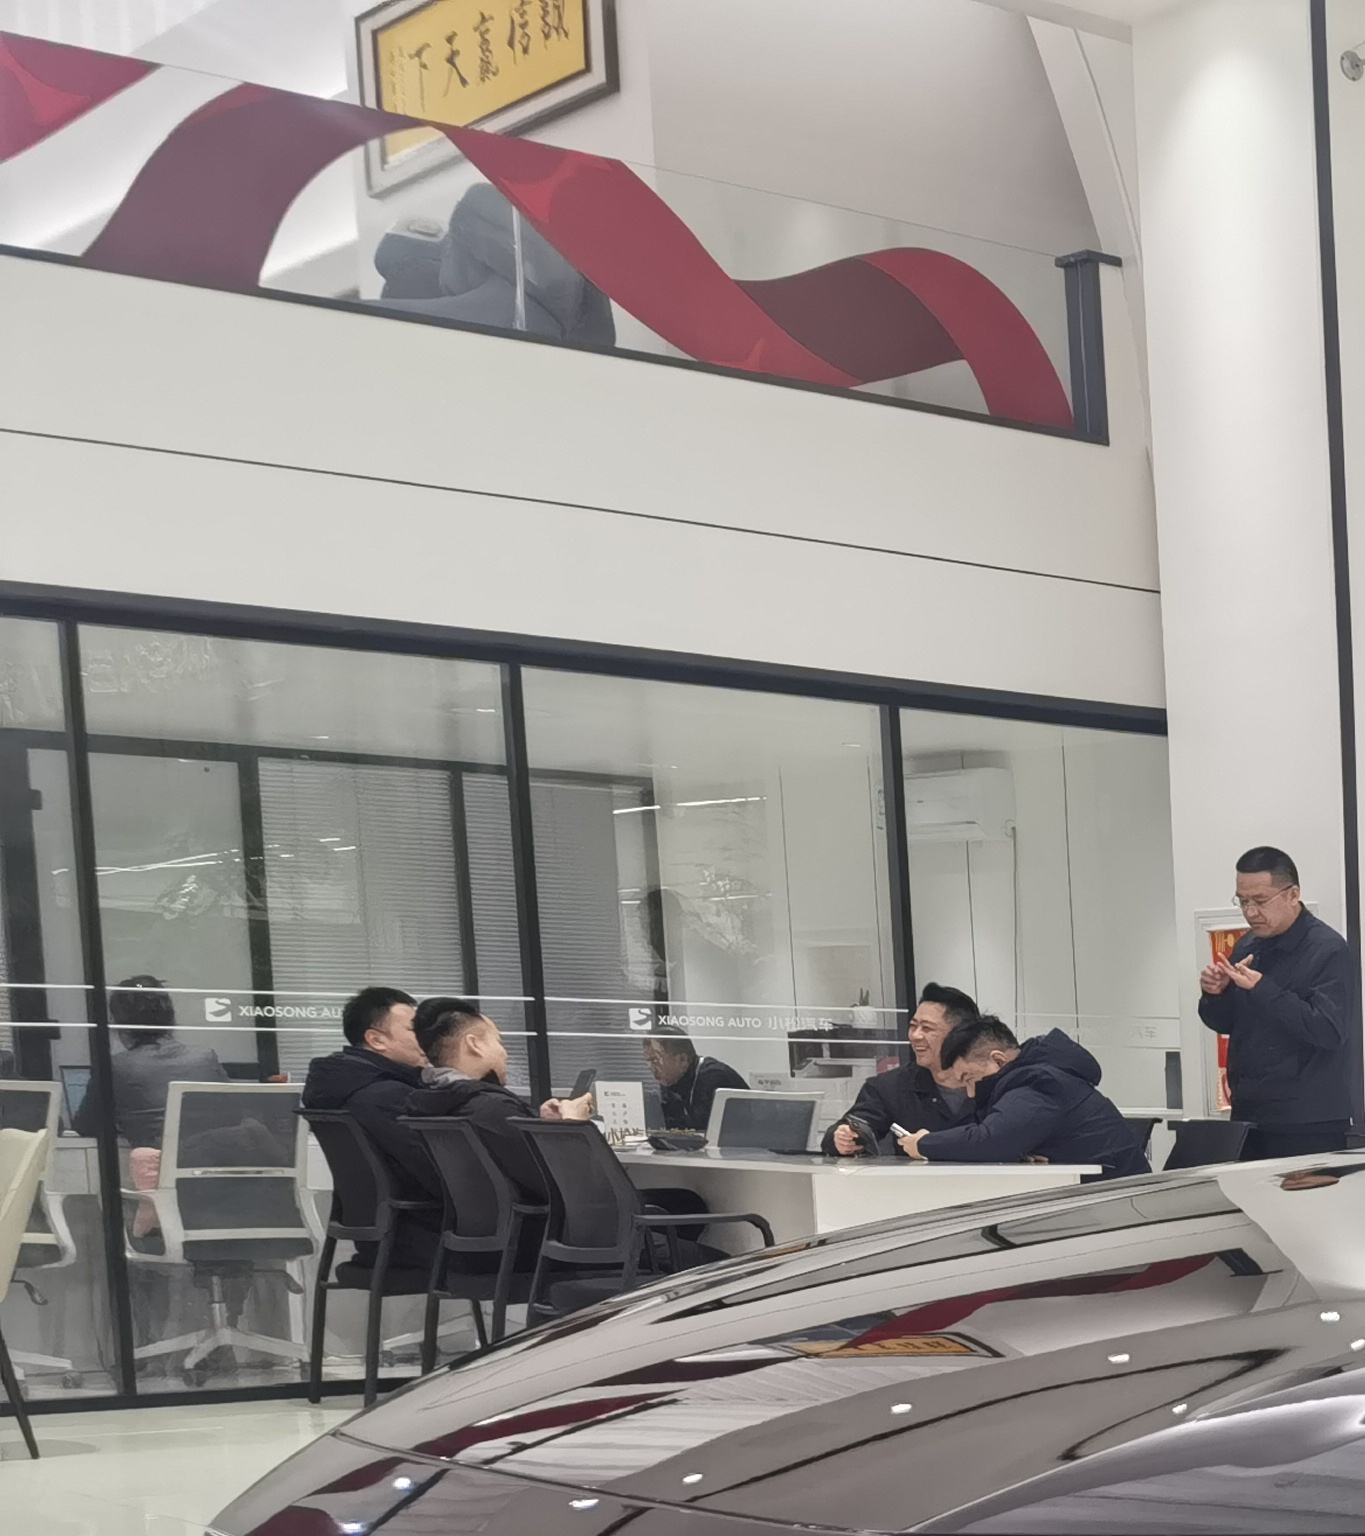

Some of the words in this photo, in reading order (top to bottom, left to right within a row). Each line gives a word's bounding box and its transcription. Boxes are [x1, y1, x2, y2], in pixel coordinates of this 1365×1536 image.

[238, 1005, 317, 1019] XIAOSONG
[320, 1007, 342, 1019] AU
[657, 1014, 725, 1027] XIAOSONG
[728, 1016, 762, 1028] AUTO
[768, 1015, 834, 1032] 小松汽车
